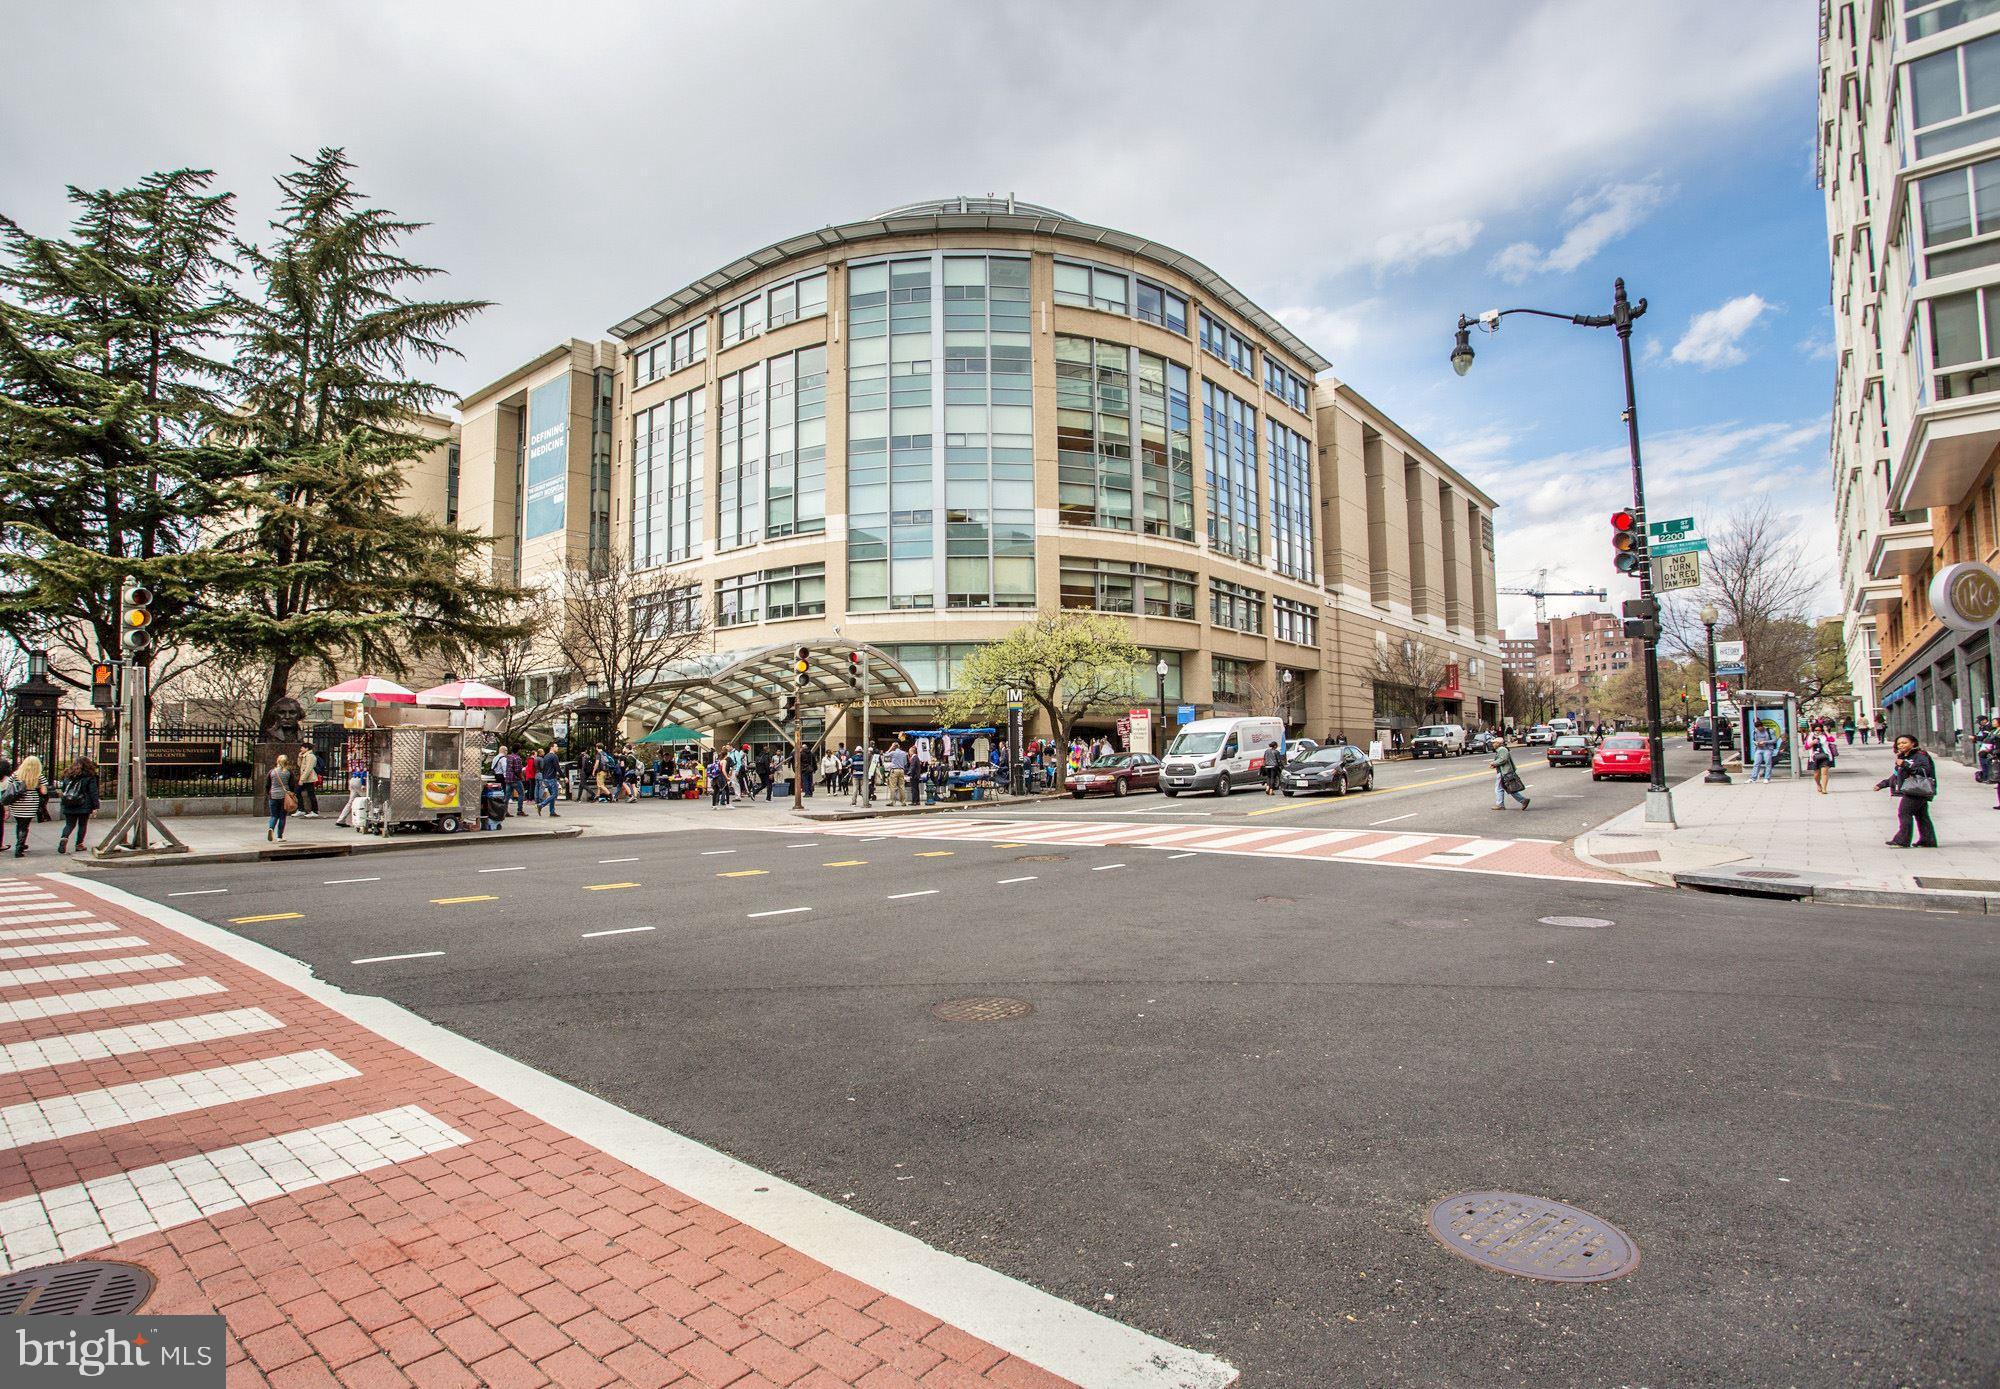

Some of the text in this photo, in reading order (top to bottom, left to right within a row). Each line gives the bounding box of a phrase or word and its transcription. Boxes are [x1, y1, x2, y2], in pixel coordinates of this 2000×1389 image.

[531, 422, 565, 446] DEFINING
[530, 436, 565, 459] MEDICINE
[1663, 523, 1668, 533] I
[1660, 533, 1684, 542] 2200
[1669, 563, 1691, 572] TURN
[1679, 570, 1696, 578] RED
[1664, 577, 1697, 588] 7AM-7PM
[1010, 689, 1022, 701] M
[882, 698, 945, 707] WASHINGTON
